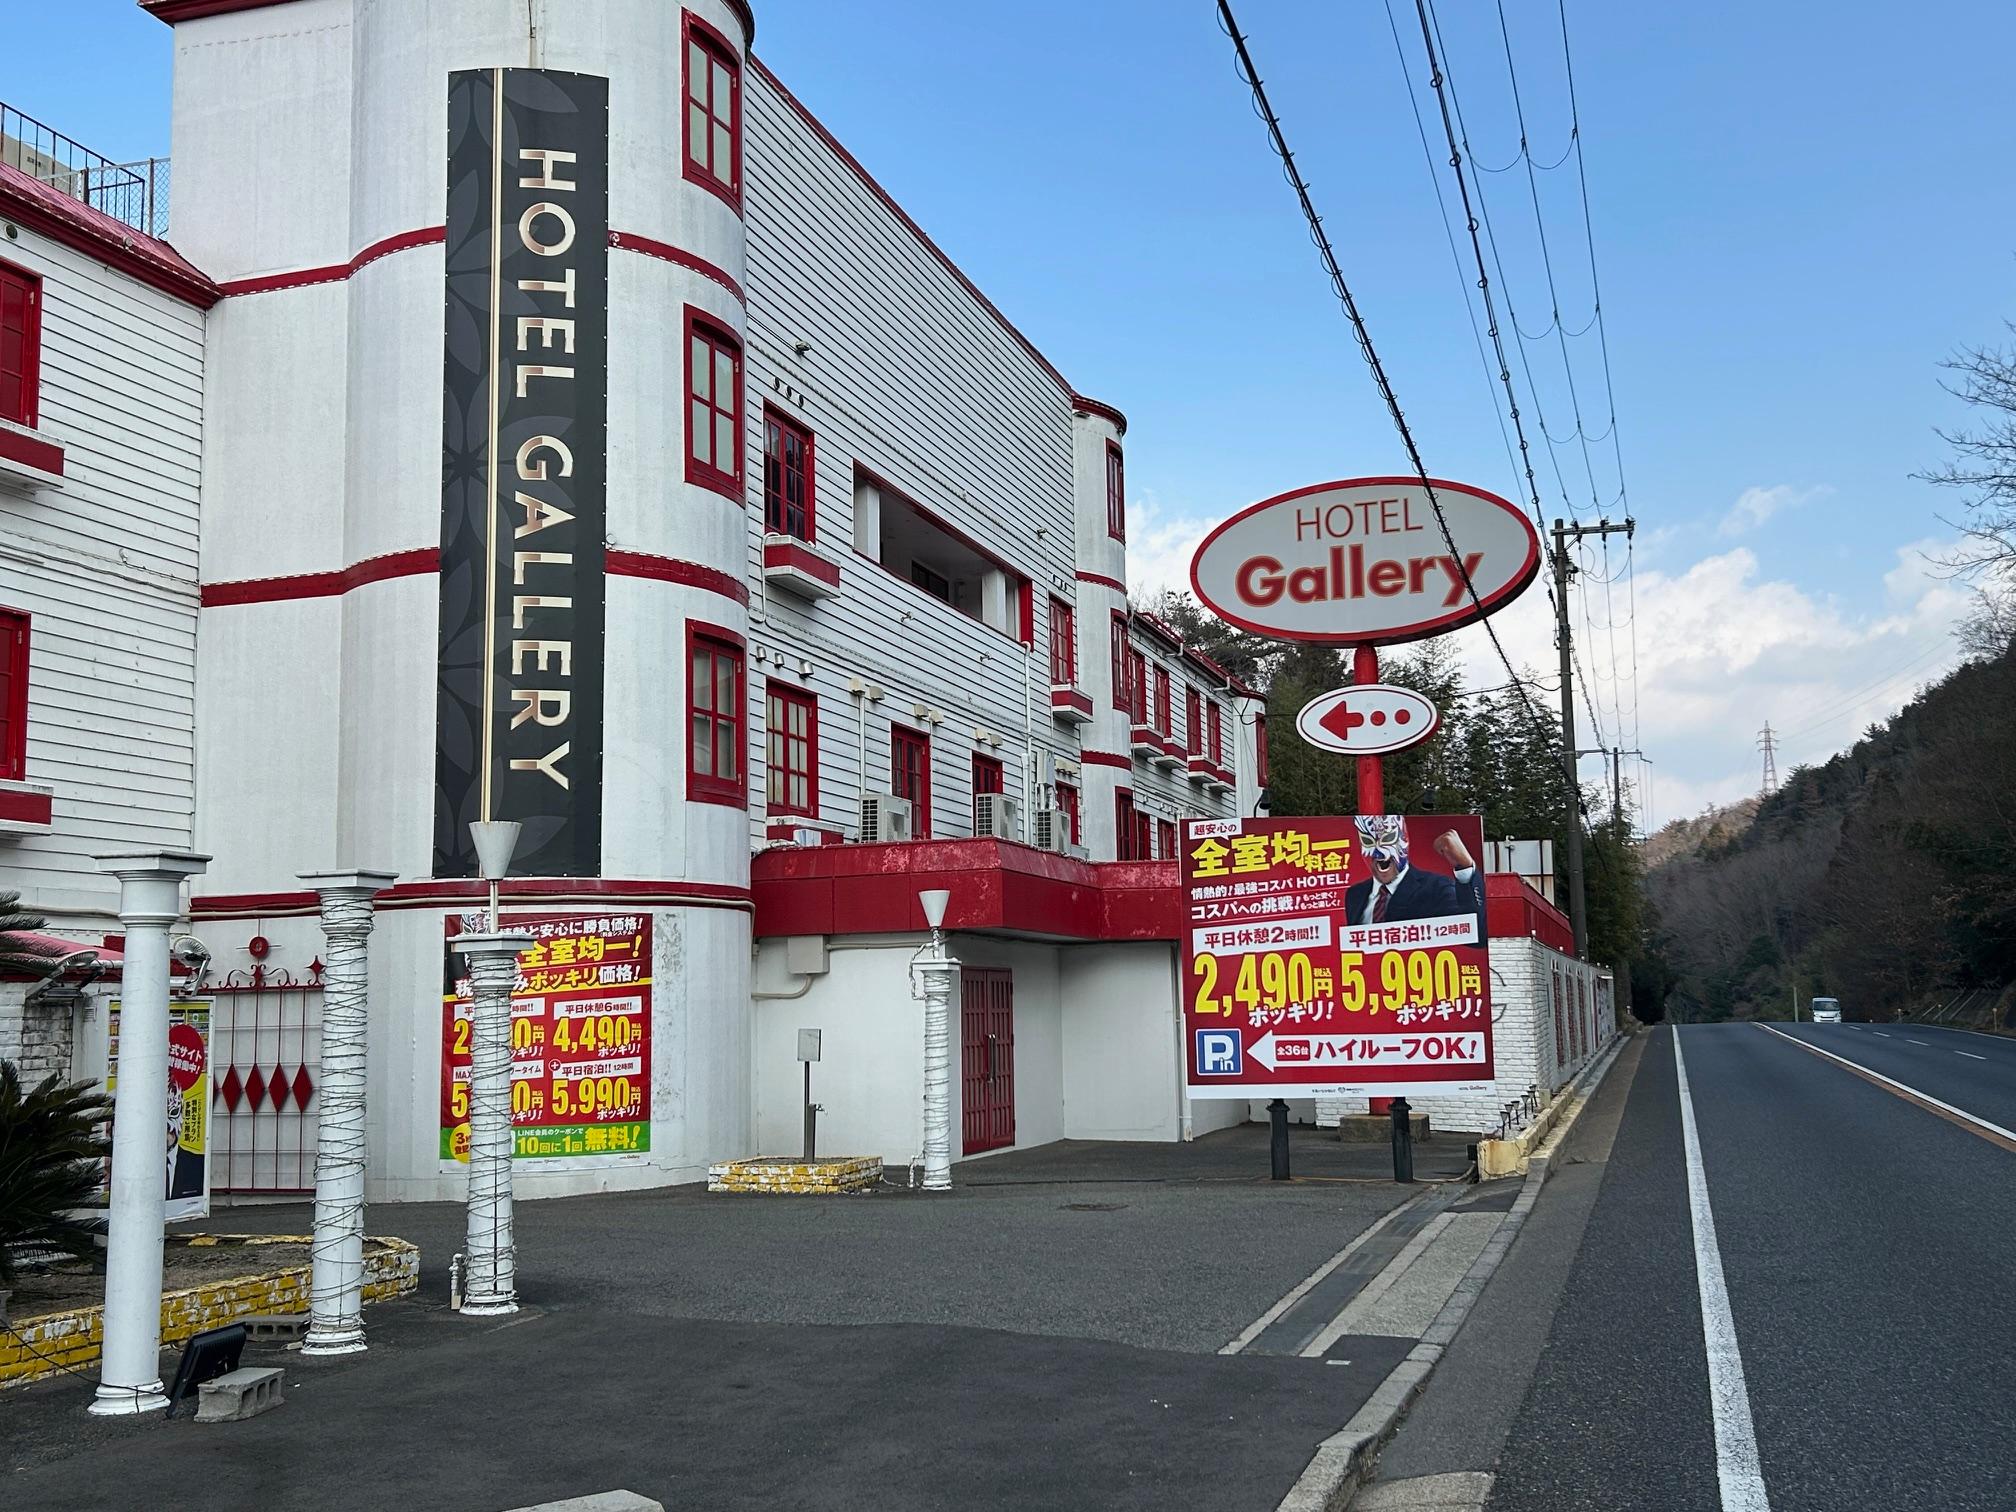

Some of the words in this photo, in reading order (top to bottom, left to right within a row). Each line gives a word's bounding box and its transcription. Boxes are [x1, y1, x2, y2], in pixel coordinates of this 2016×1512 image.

[517, 149, 576, 397] HOTEL
[1296, 498, 1423, 541] HOTEL
[1235, 543, 1484, 607] Gallery
[510, 435, 576, 790] GALLERY
[1194, 823, 1237, 835] 超安心の
[1191, 831, 1350, 878] 全室均一
[1434, 923, 1471, 937] 12時間
[168, 1042, 202, 1062] 式サイト
[1314, 1037, 1477, 1060] ハイルーフOK!
